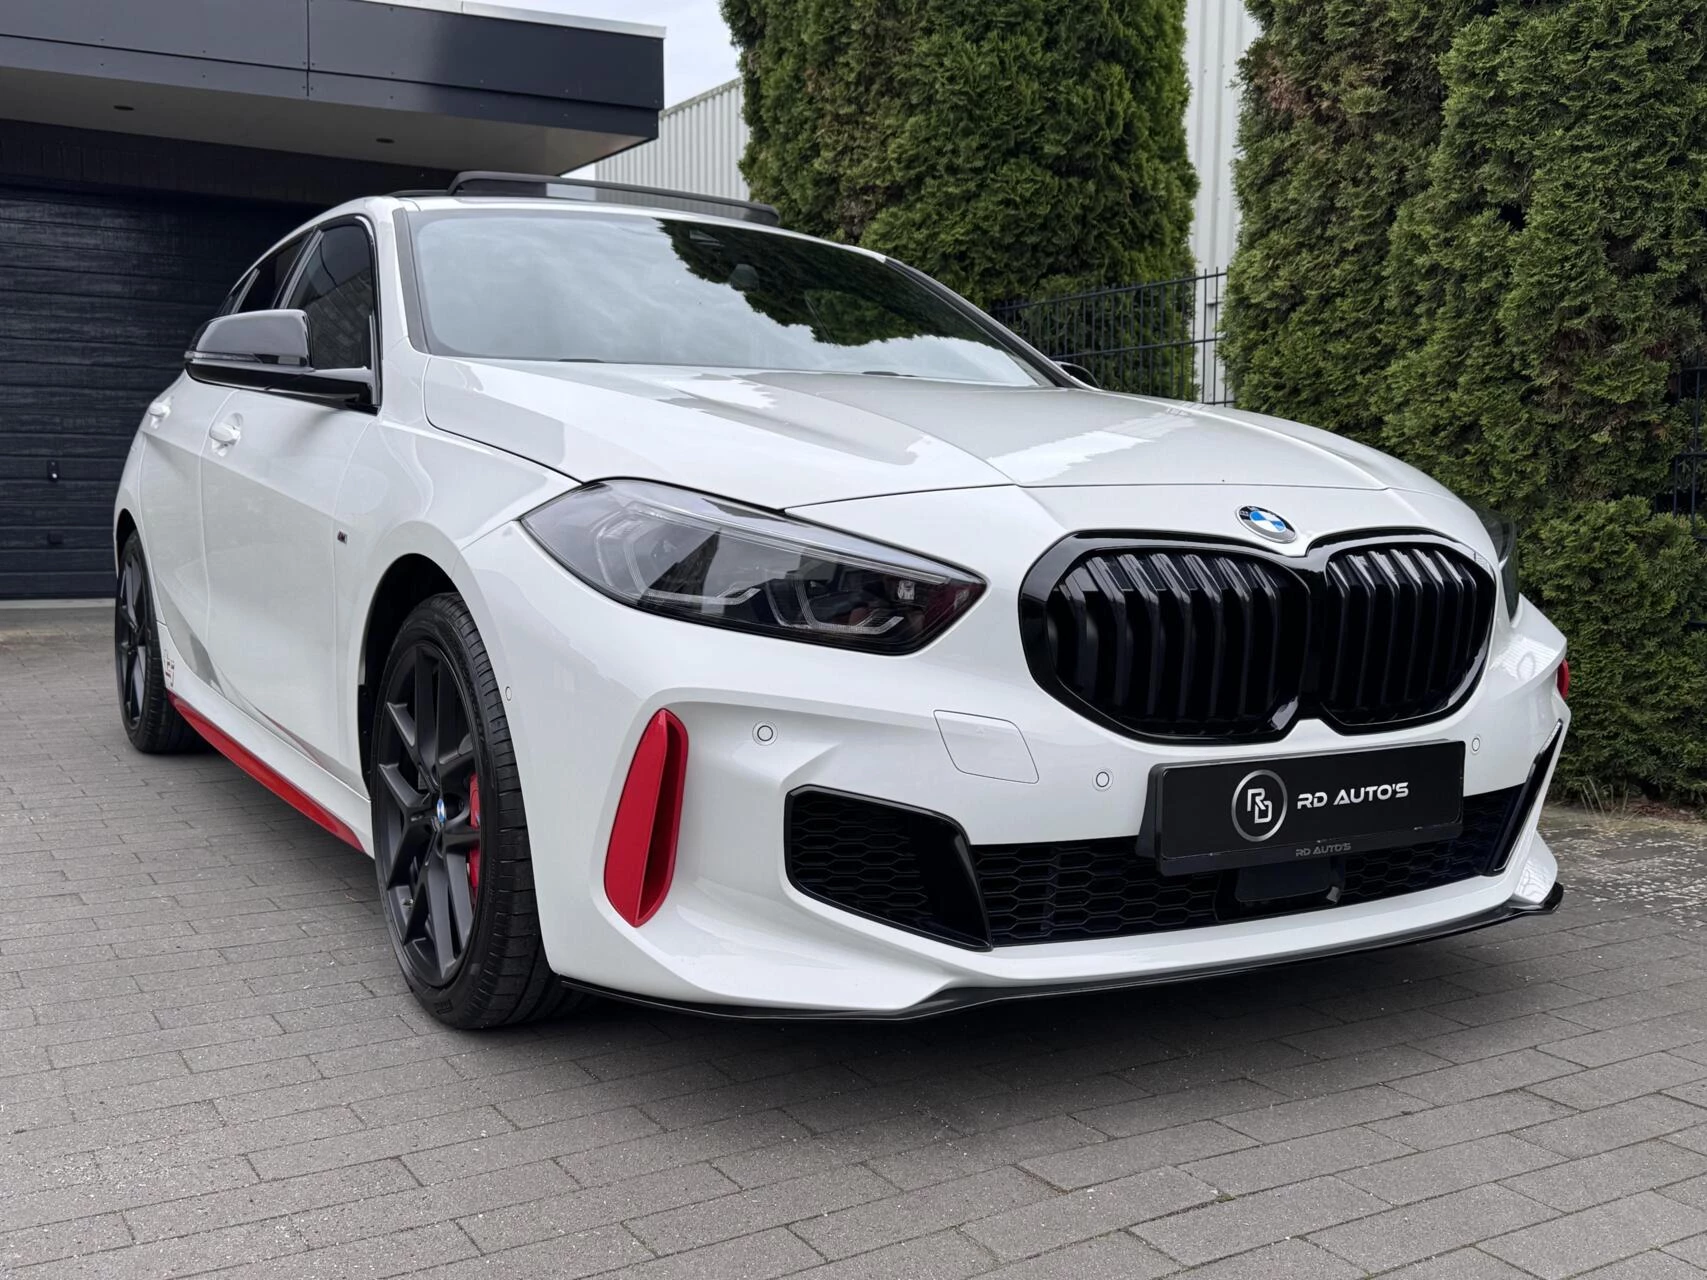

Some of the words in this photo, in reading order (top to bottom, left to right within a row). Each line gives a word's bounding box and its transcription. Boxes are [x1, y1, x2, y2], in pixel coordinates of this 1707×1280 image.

[1297, 791, 1328, 810] RD
[1332, 781, 1409, 806] AUTO'S
[1295, 848, 1311, 857] RD
